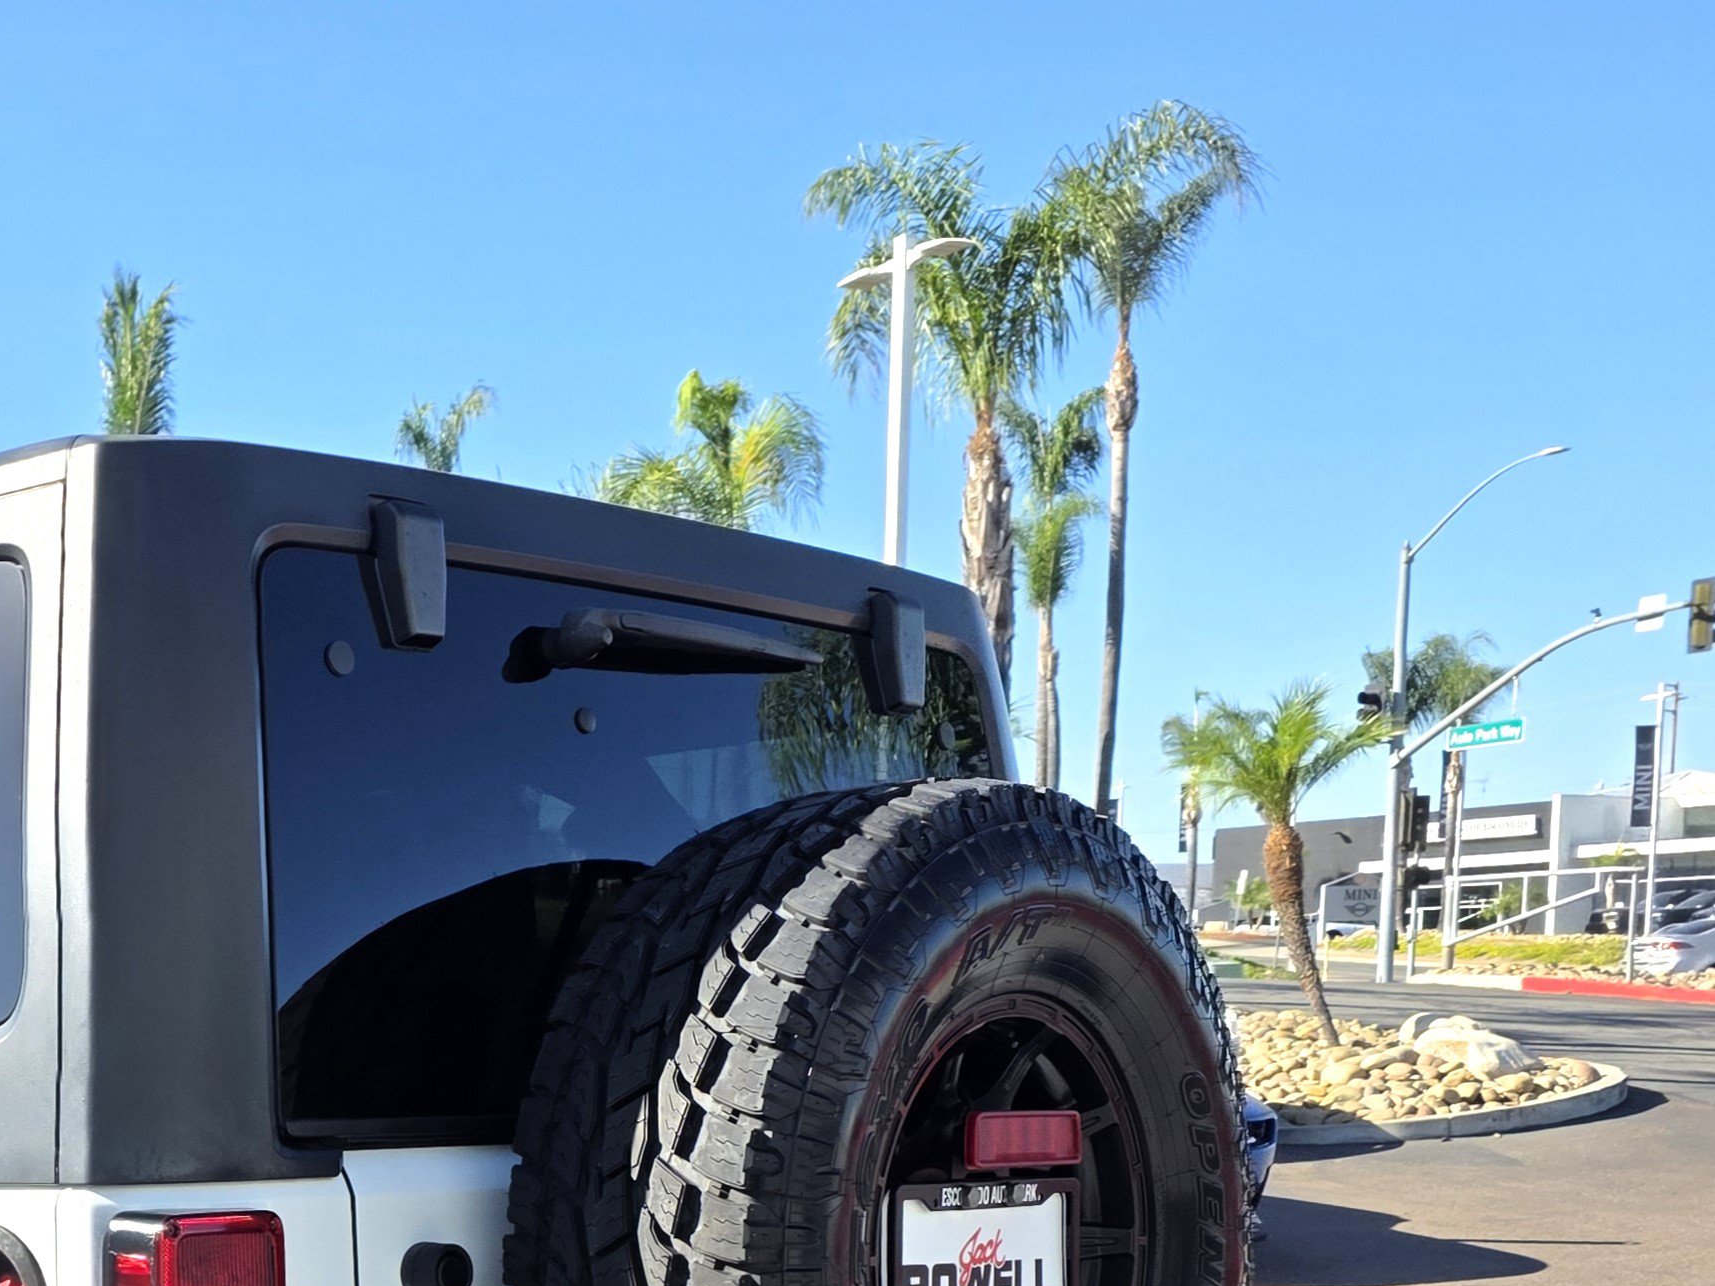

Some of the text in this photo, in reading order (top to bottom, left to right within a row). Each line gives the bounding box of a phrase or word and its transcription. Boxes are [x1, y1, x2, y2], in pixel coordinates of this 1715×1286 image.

[1450, 724, 1522, 746] Auto Park Way
[1633, 765, 1653, 810] MINI
[1344, 888, 1378, 900] MINI
